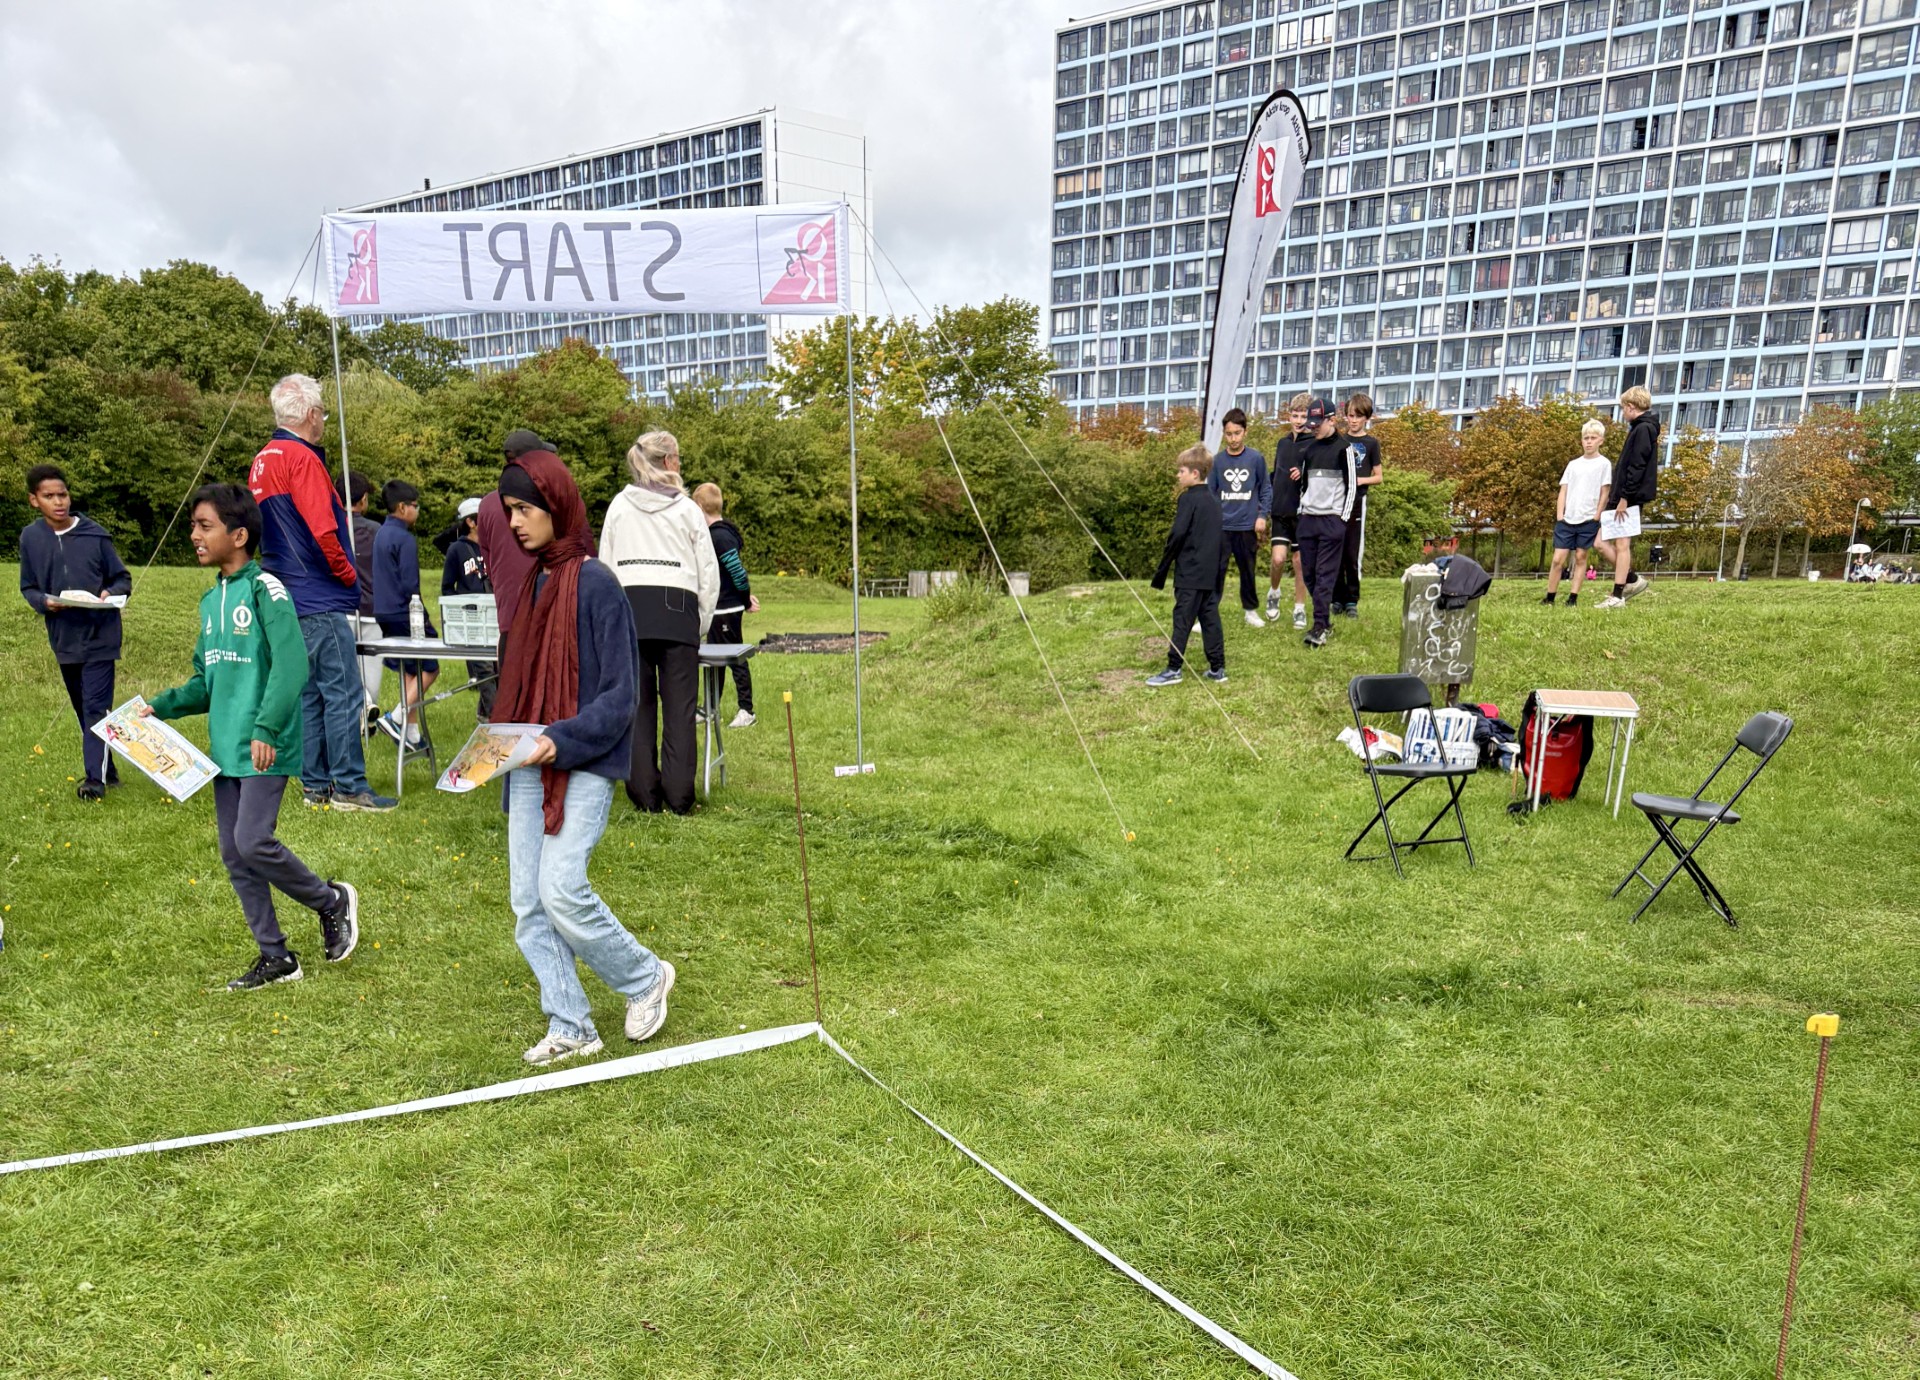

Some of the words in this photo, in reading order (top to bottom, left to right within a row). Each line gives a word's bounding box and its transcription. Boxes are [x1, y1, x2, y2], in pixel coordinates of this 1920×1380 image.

[1266, 102, 1279, 121] Aktiv
[1290, 114, 1301, 137] Aktiv
[1221, 490, 1252, 500] hummel
